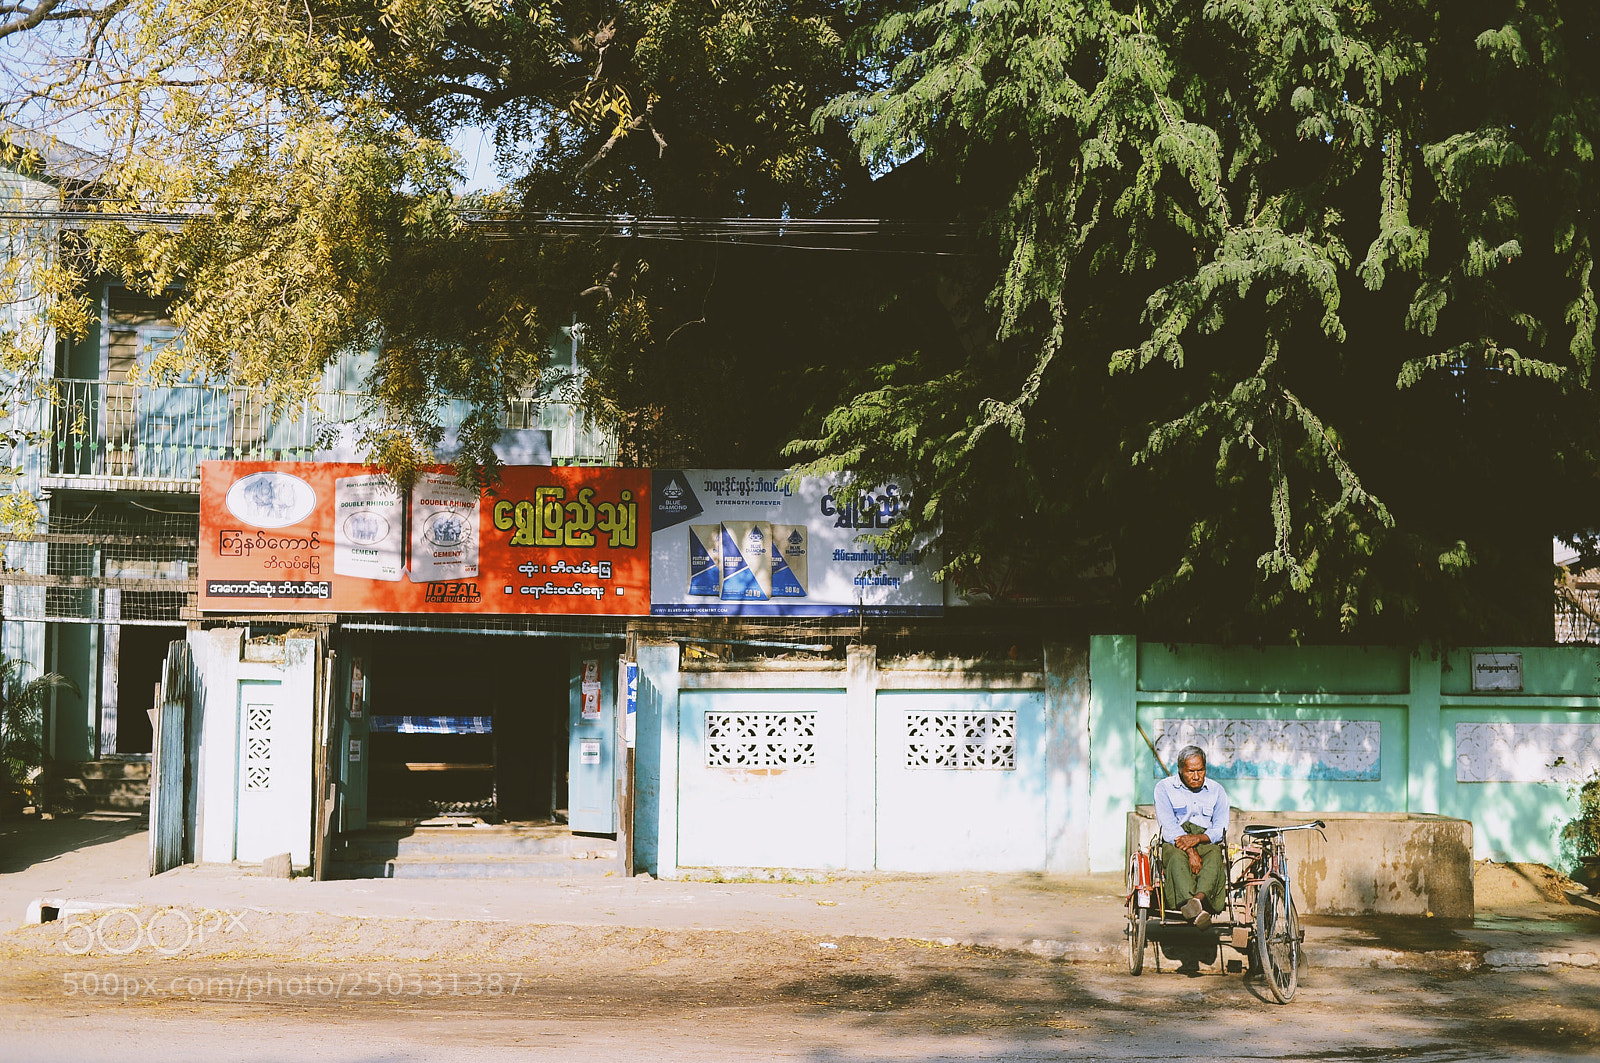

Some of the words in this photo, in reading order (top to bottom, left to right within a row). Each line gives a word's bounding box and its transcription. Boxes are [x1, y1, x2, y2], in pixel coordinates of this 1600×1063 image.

[420, 498, 447, 506] DOUBLE
[449, 500, 475, 508] RHINOS
[351, 548, 378, 556] CEMENT
[426, 583, 478, 597] IDEAL
